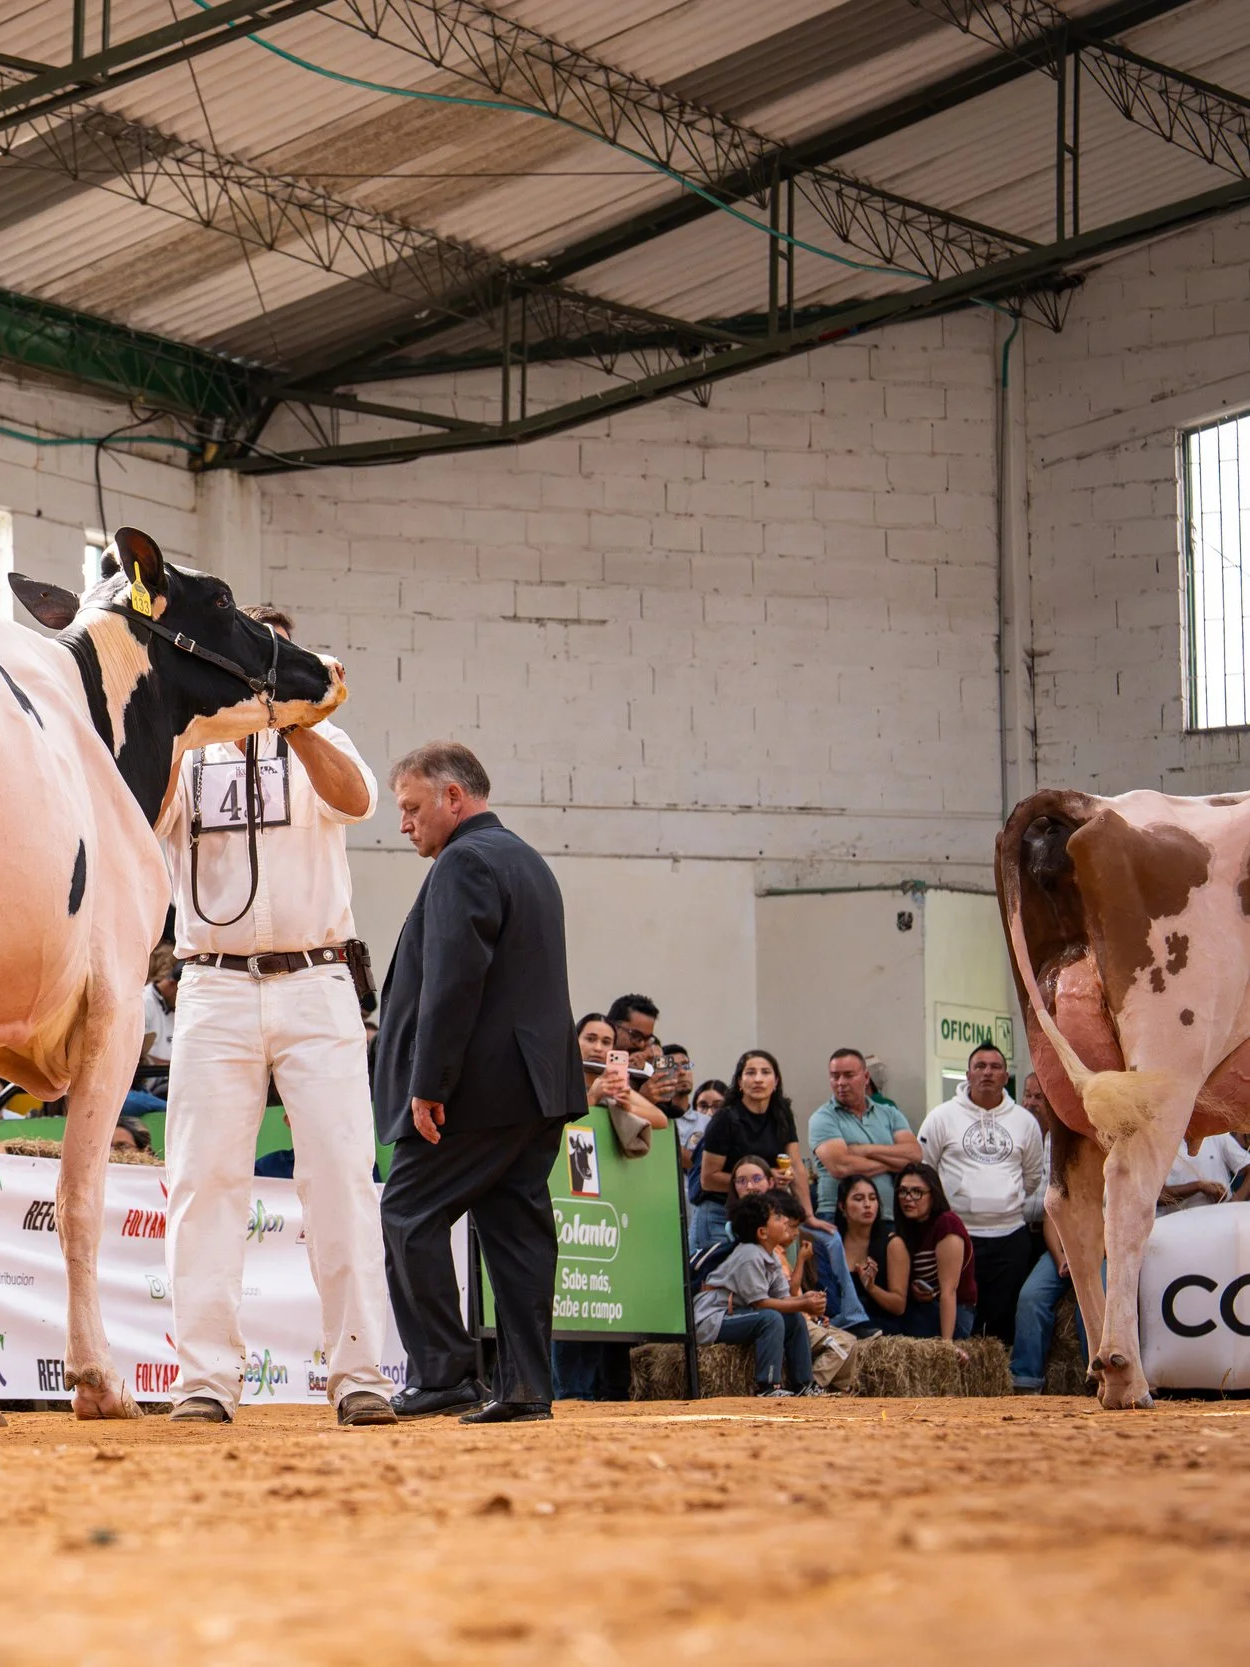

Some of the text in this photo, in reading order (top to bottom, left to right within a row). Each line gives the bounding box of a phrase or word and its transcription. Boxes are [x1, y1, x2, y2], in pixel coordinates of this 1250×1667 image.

[941, 1018, 993, 1044] OFICINA
[122, 1209, 166, 1239] FOLYAM
[561, 1267, 611, 1294] Sabe más,
[553, 1294, 622, 1324] Sabe a campo
